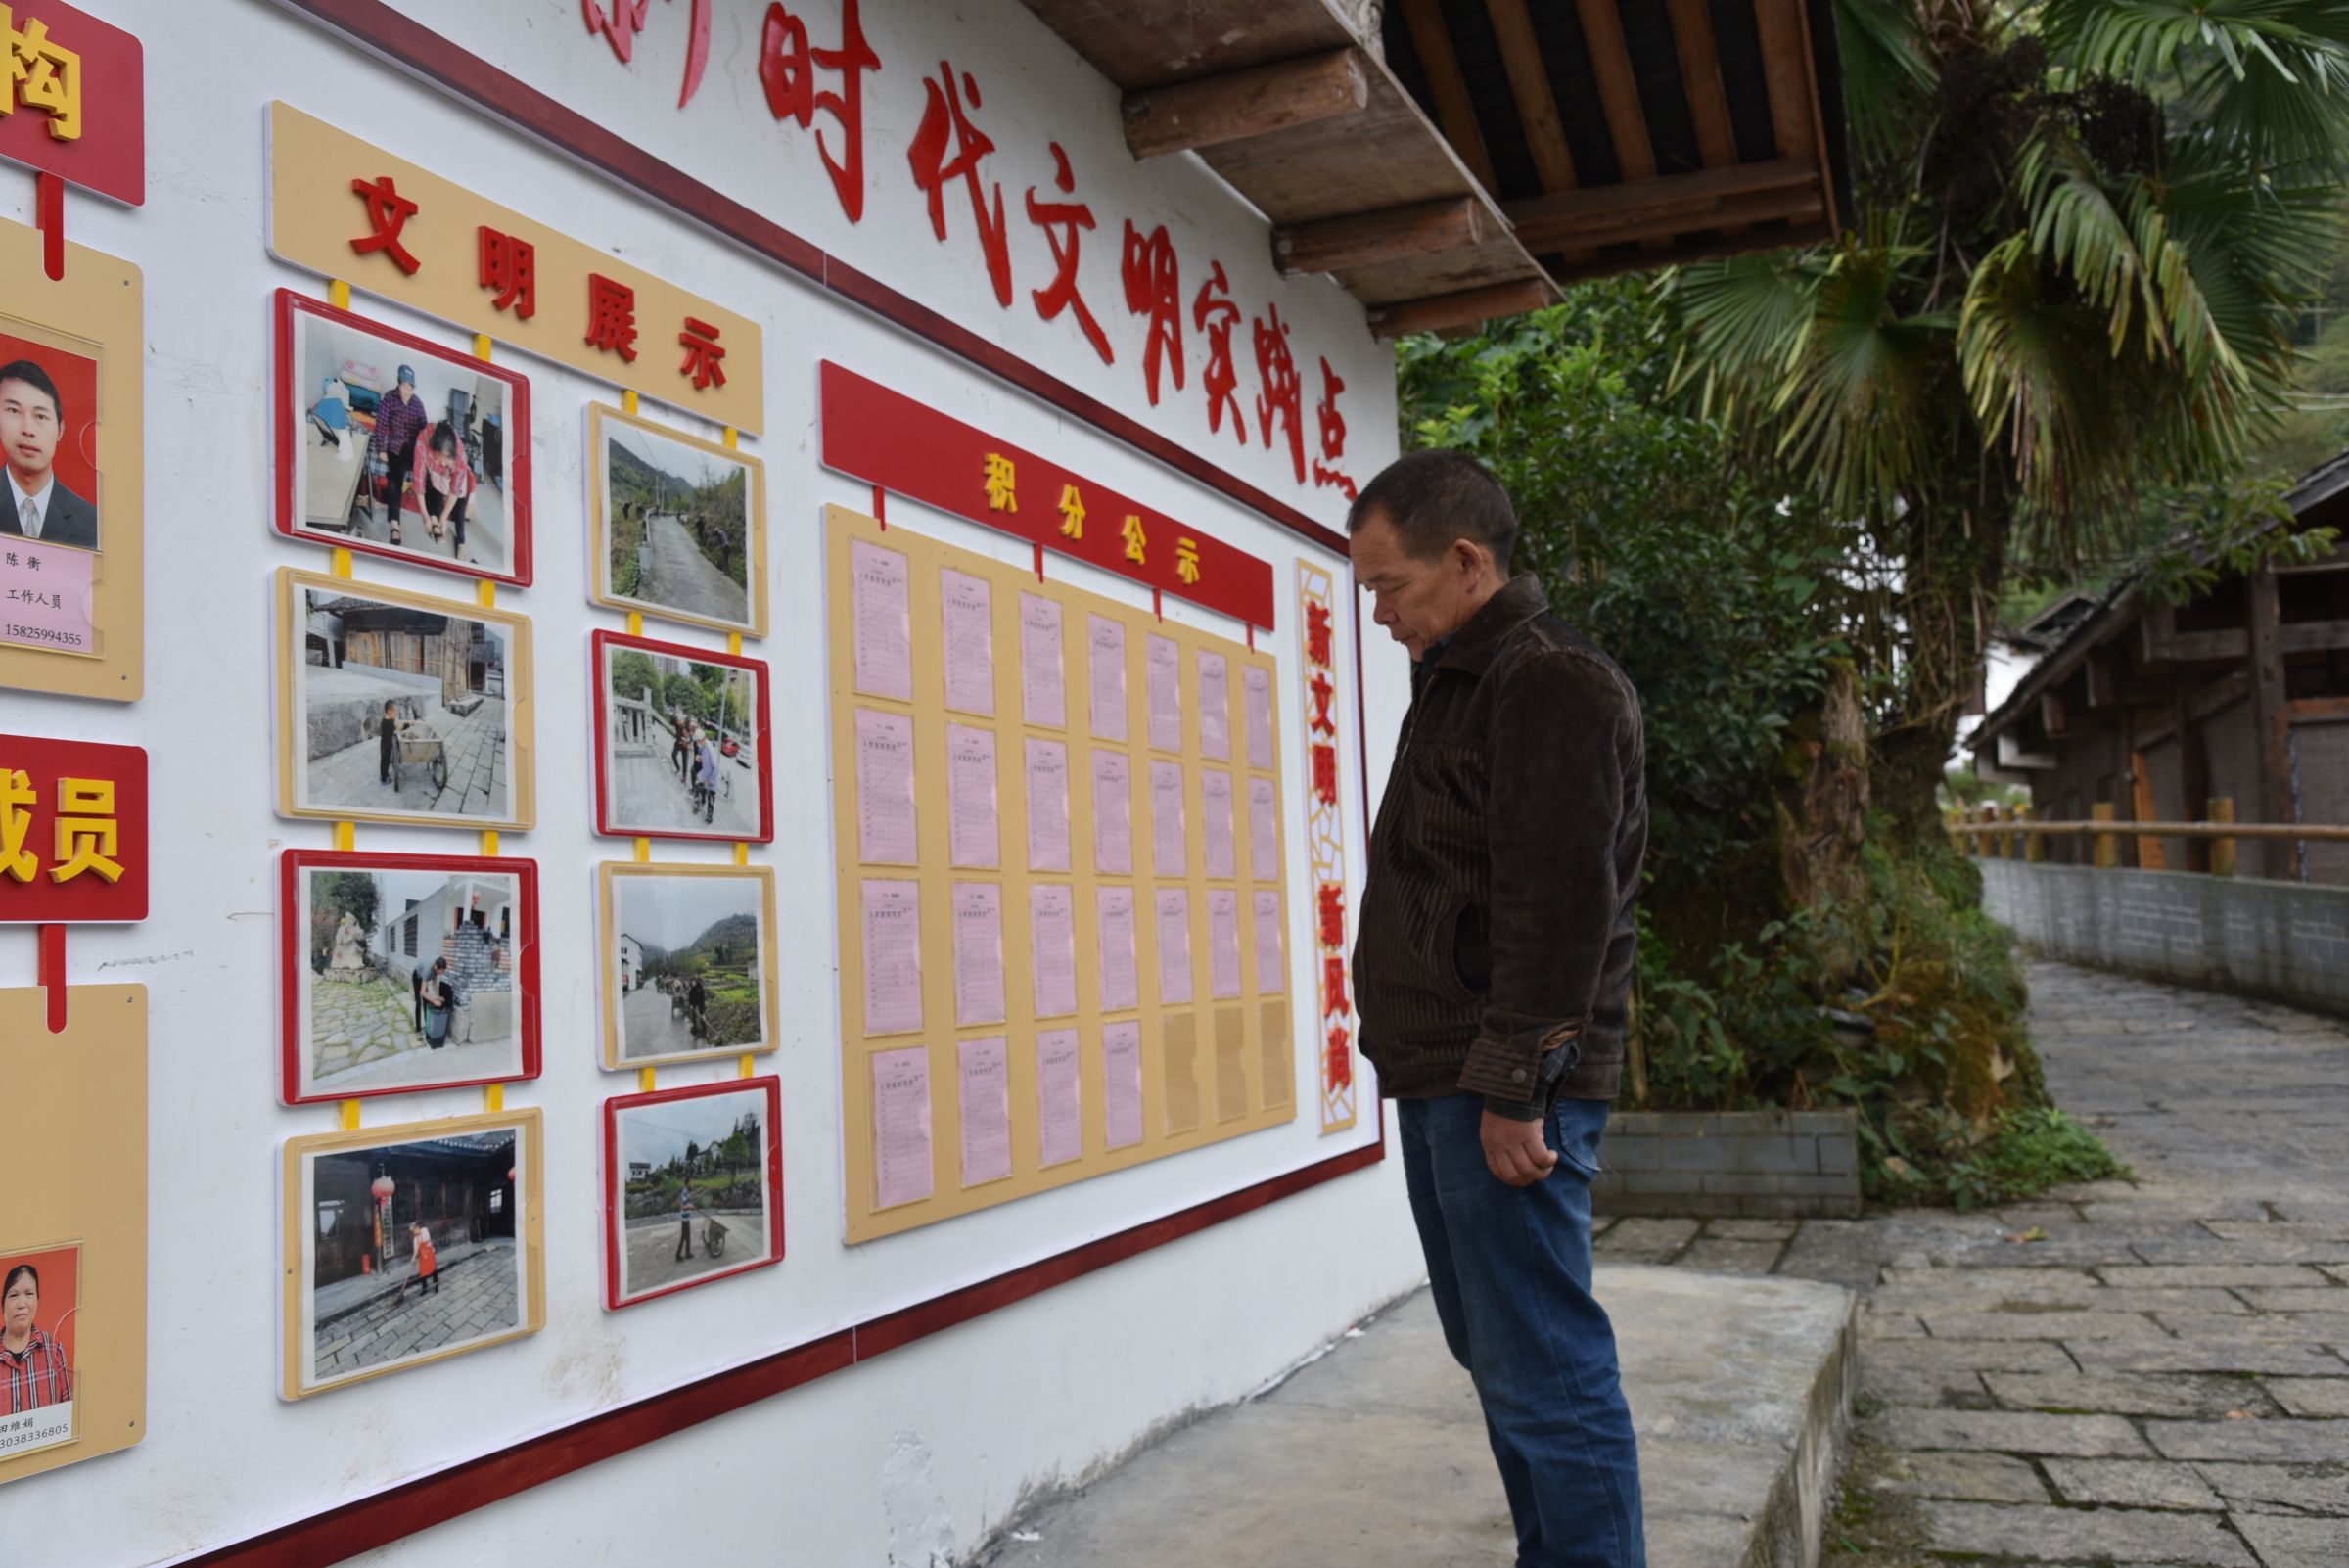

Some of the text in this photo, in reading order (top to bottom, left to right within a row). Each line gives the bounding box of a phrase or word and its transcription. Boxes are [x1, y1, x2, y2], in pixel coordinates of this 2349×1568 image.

[0, 1, 81, 141] 构
[350, 176, 727, 390] 文明展示
[983, 452, 1201, 585] 积分公示
[6, 589, 62, 609] 工作人员
[6, 623, 82, 646] 15825994355
